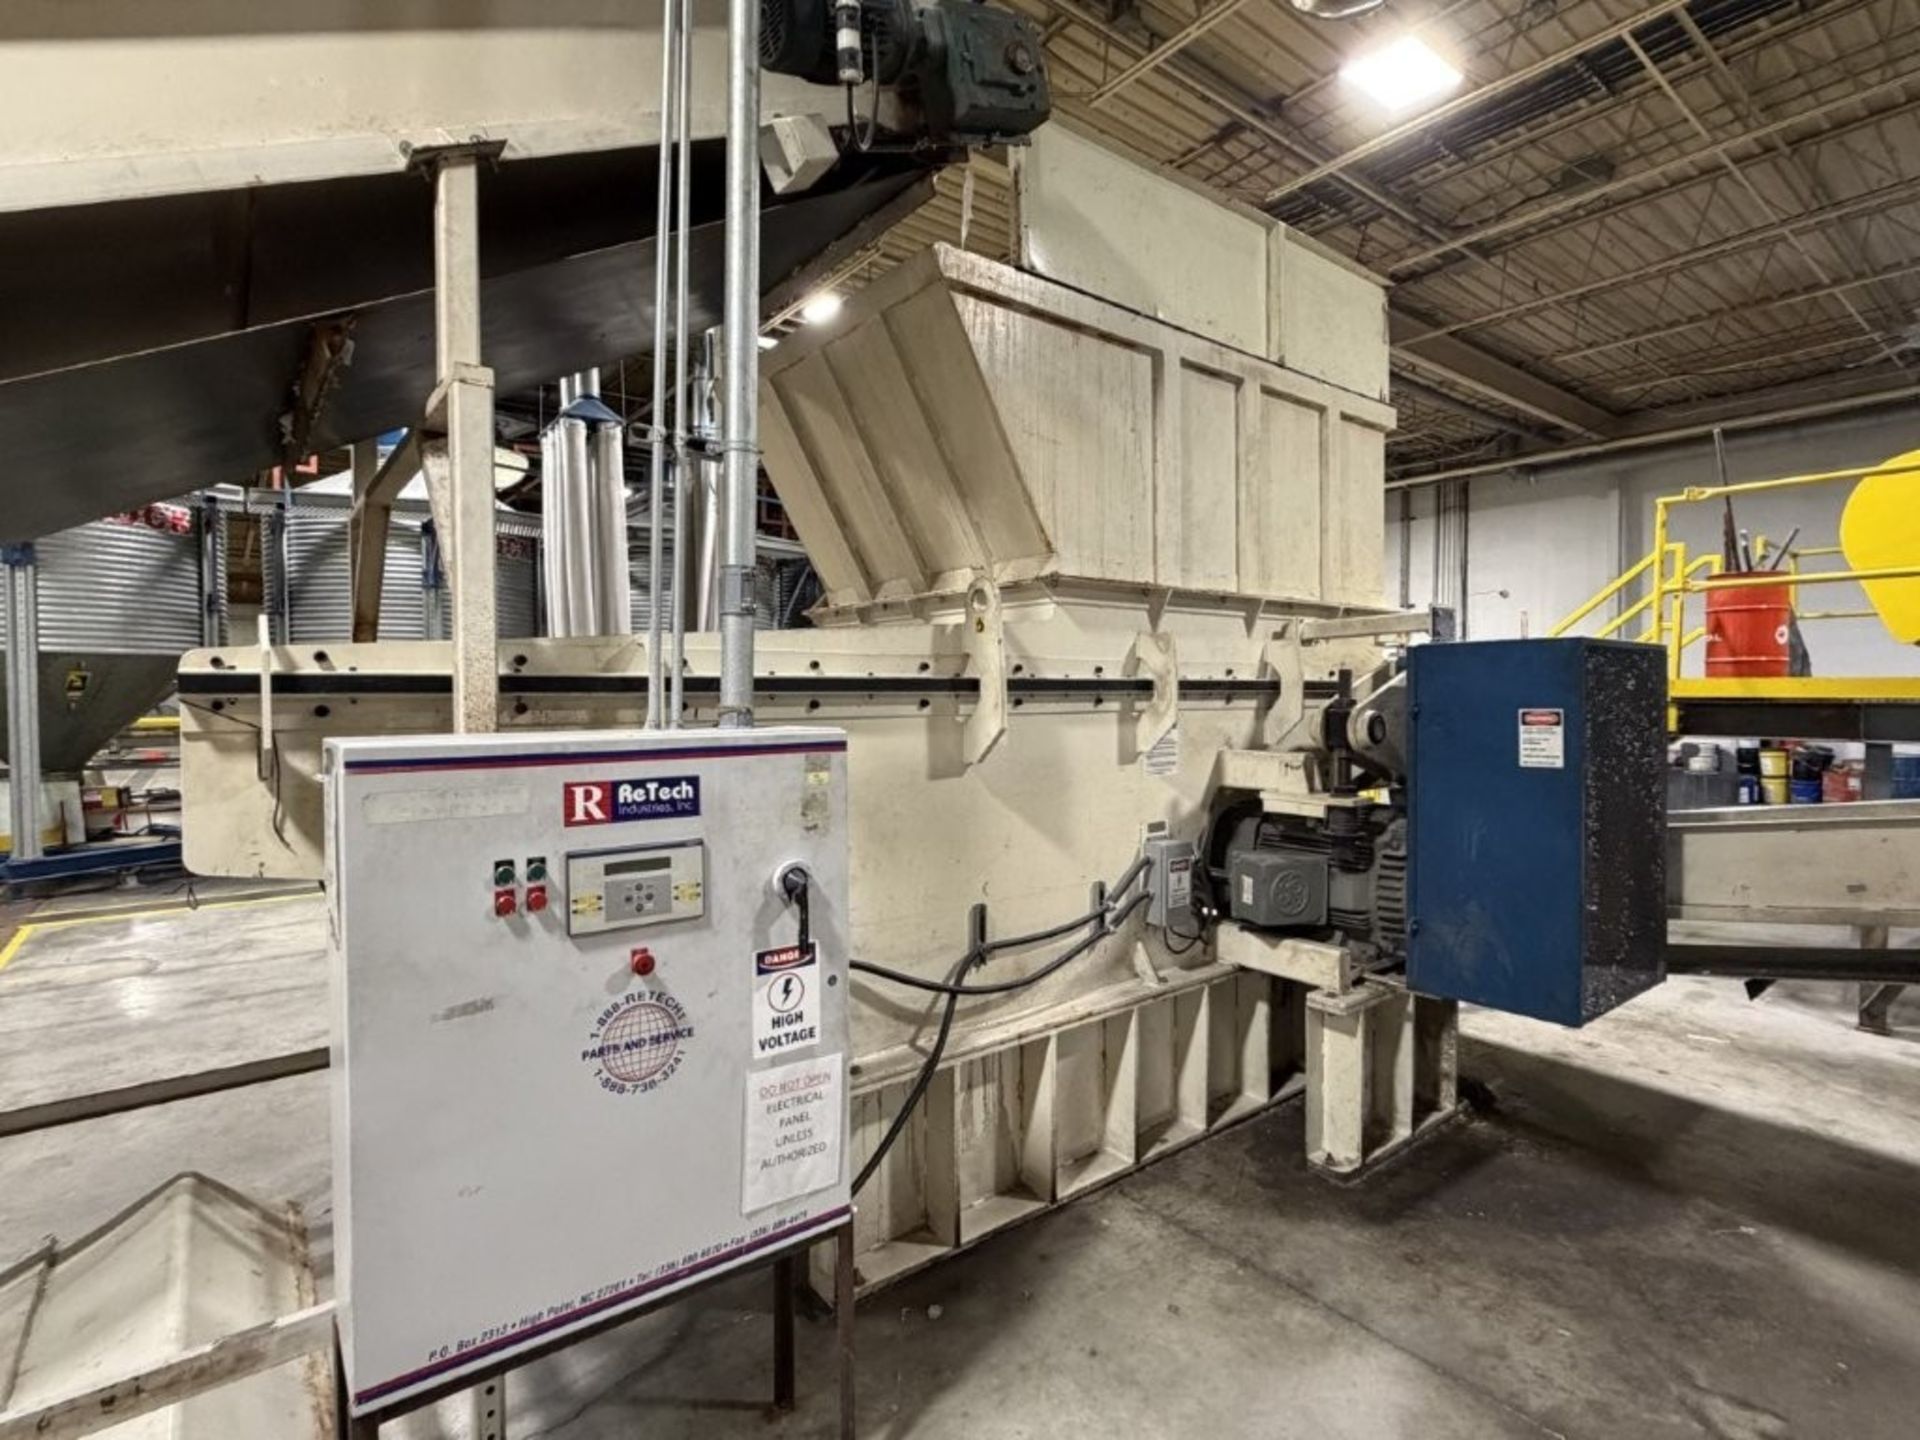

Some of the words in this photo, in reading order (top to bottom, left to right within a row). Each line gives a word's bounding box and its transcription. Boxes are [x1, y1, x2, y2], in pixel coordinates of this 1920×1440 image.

[570, 785, 607, 821] R
[618, 781, 694, 803] ReTech
[771, 1010, 804, 1029] HIGH
[582, 1043, 621, 1061] PARTS
[623, 1037, 647, 1051] AND
[649, 1026, 694, 1046] SERVICE
[758, 1026, 816, 1051] VOLTAGE
[766, 1090, 824, 1114] ELECTRICAL
[779, 1111, 813, 1128] PANEL
[775, 1128, 814, 1148] UNLESS
[760, 1141, 828, 1171] AUTHORIZED
[457, 1336, 478, 1352] Box
